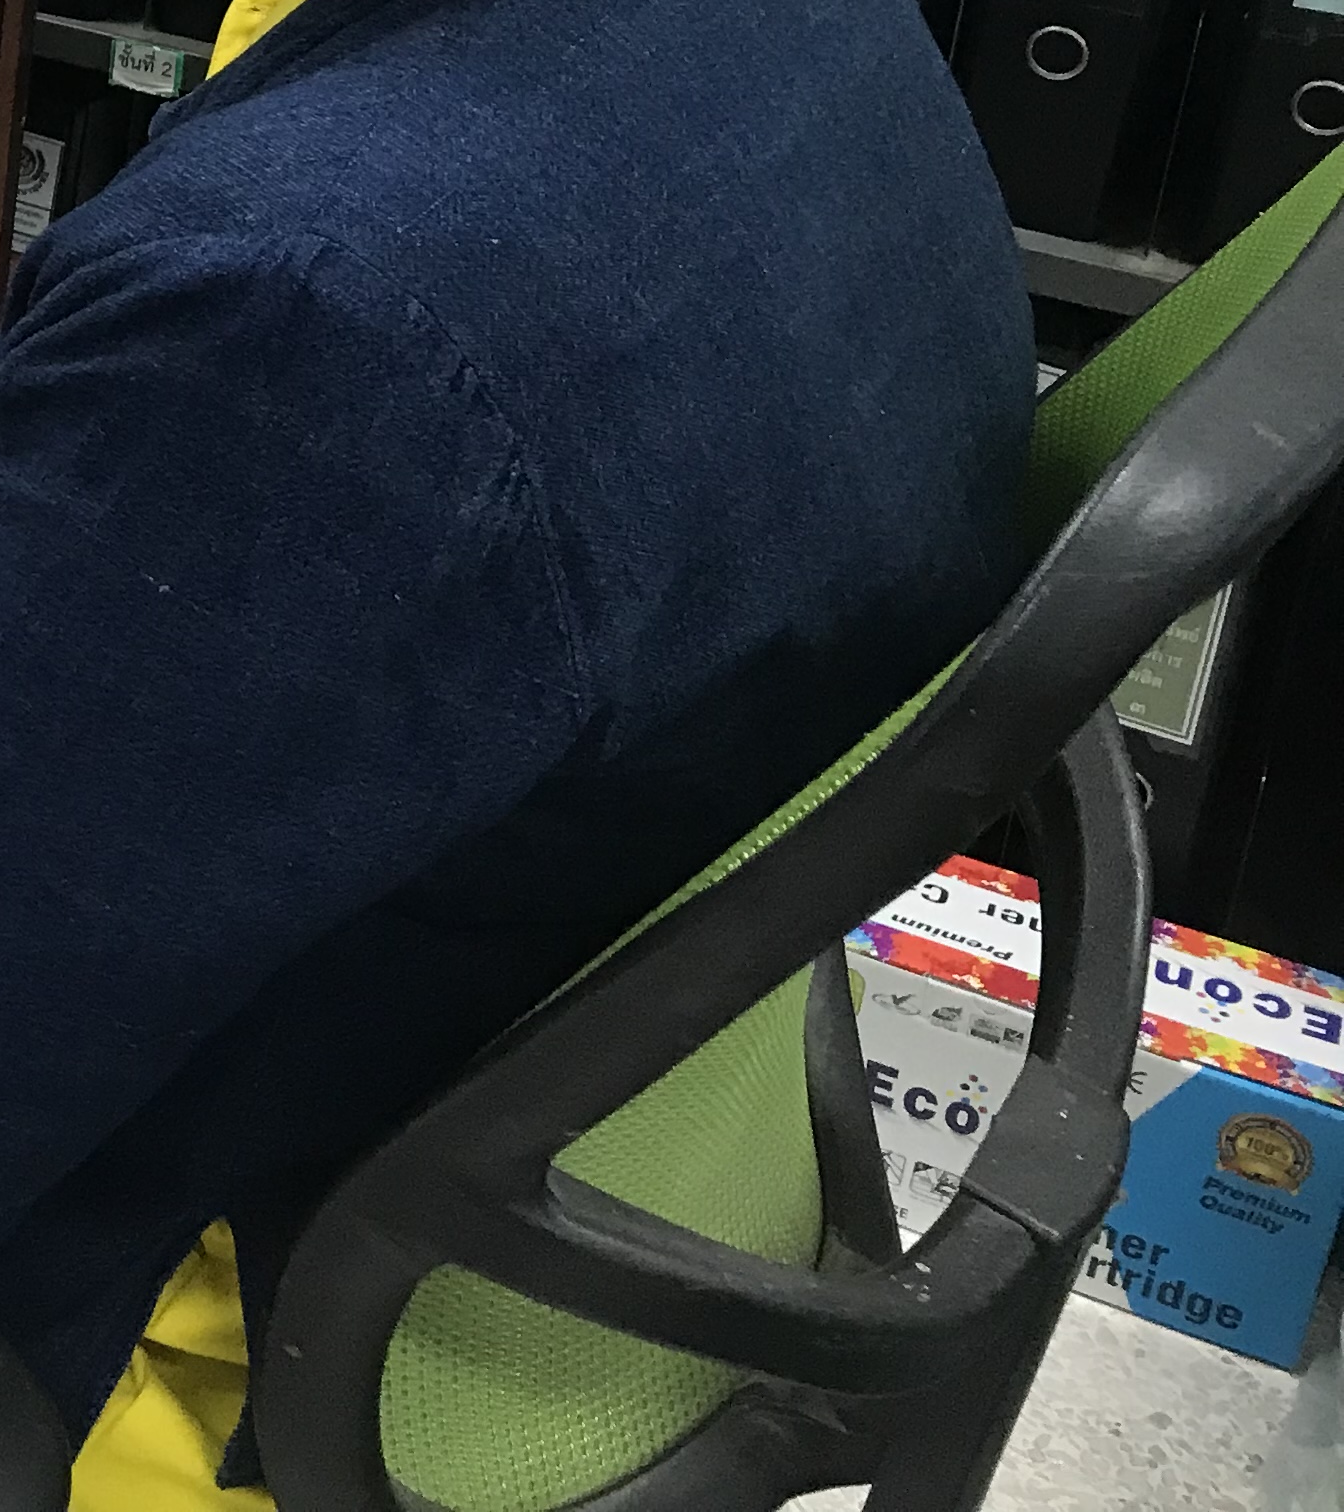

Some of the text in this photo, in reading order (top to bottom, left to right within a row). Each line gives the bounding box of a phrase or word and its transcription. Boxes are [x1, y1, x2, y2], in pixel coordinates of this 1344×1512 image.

[118, 44, 174, 78] ชั้นที่ 2
[891, 913, 1014, 961] Premium
[978, 902, 1042, 934] ner
[1154, 958, 1343, 1043] Econ
[866, 1059, 980, 1136] Eco
[1199, 1194, 1286, 1235] Quality
[1202, 1174, 1312, 1225] Premium
[1096, 1222, 1171, 1267] ner
[1086, 1253, 1244, 1331] rtridge
